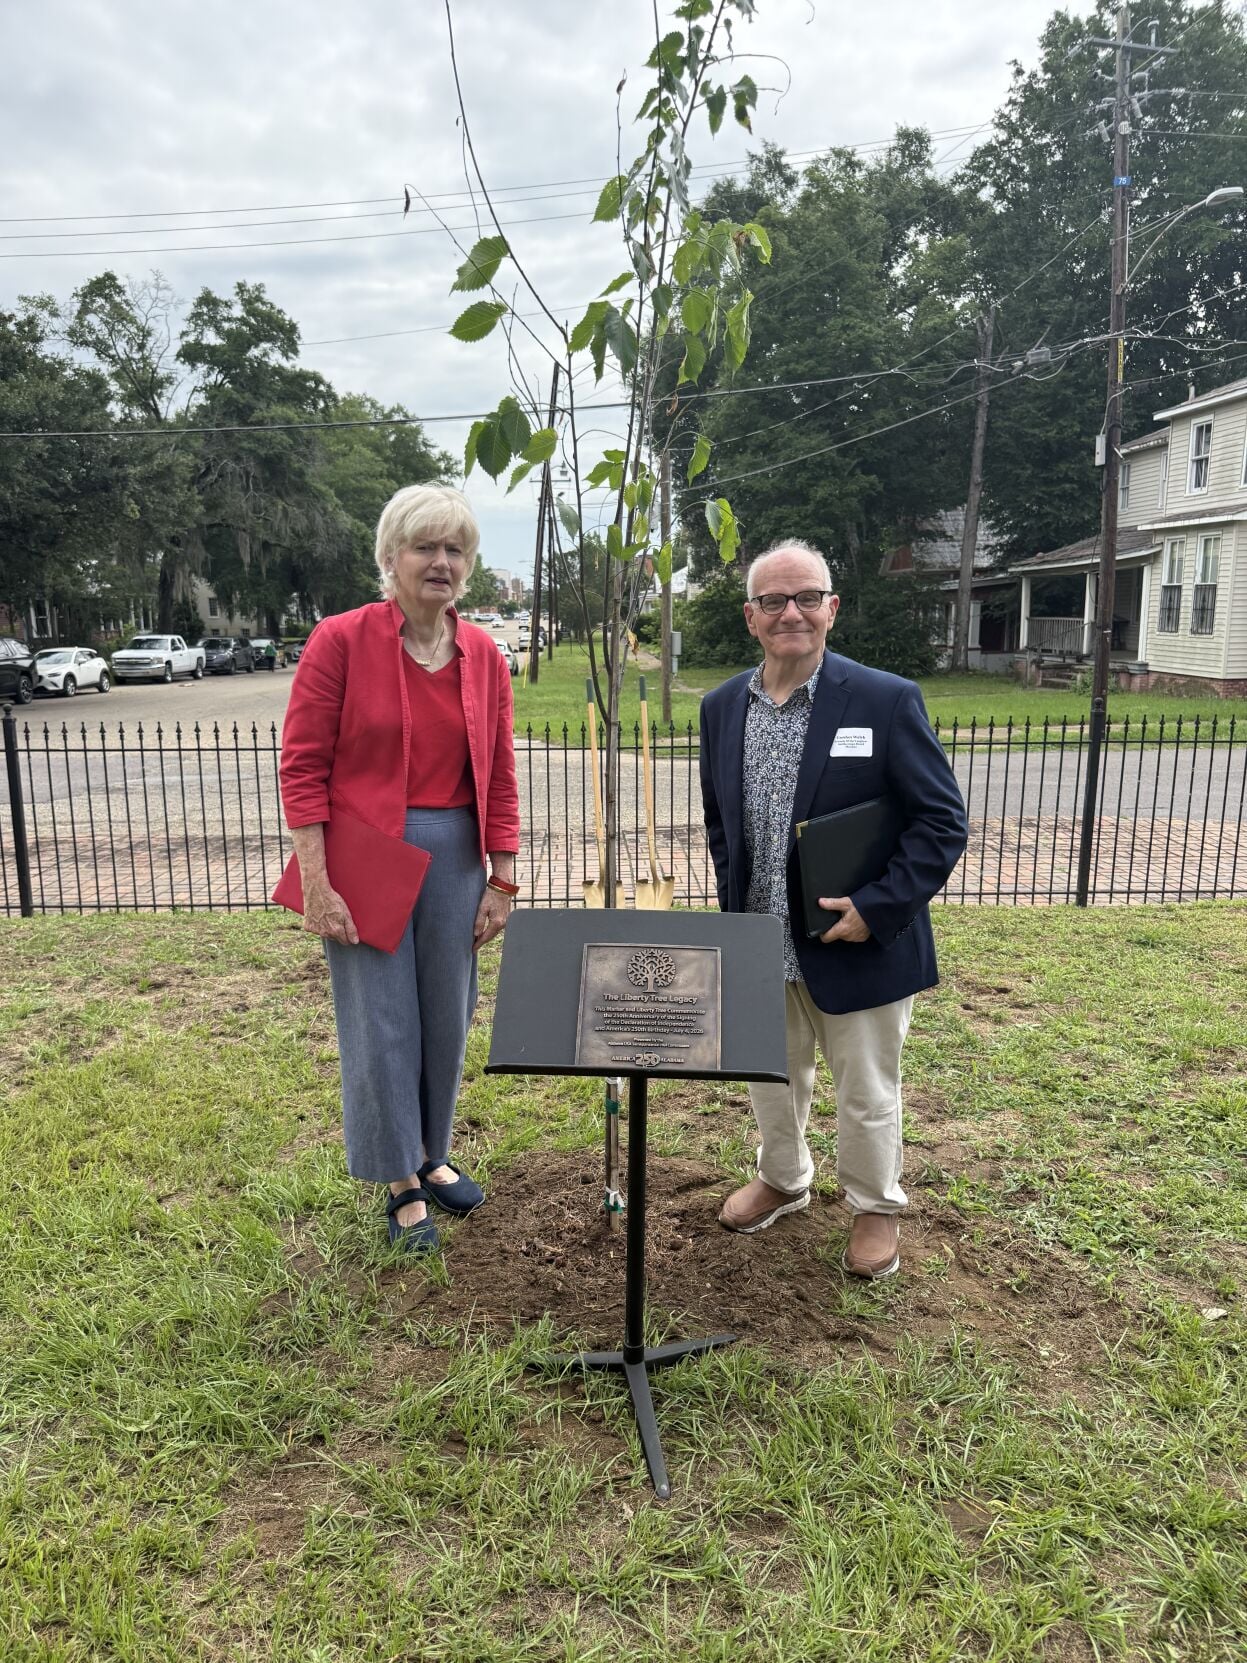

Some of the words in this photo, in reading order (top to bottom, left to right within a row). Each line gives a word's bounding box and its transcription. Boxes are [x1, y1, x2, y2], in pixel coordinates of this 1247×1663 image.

[604, 993, 619, 1002] The
[620, 994, 648, 1003] Liberty
[670, 995, 698, 1005] Legacy
[636, 1052, 660, 1066] 250
